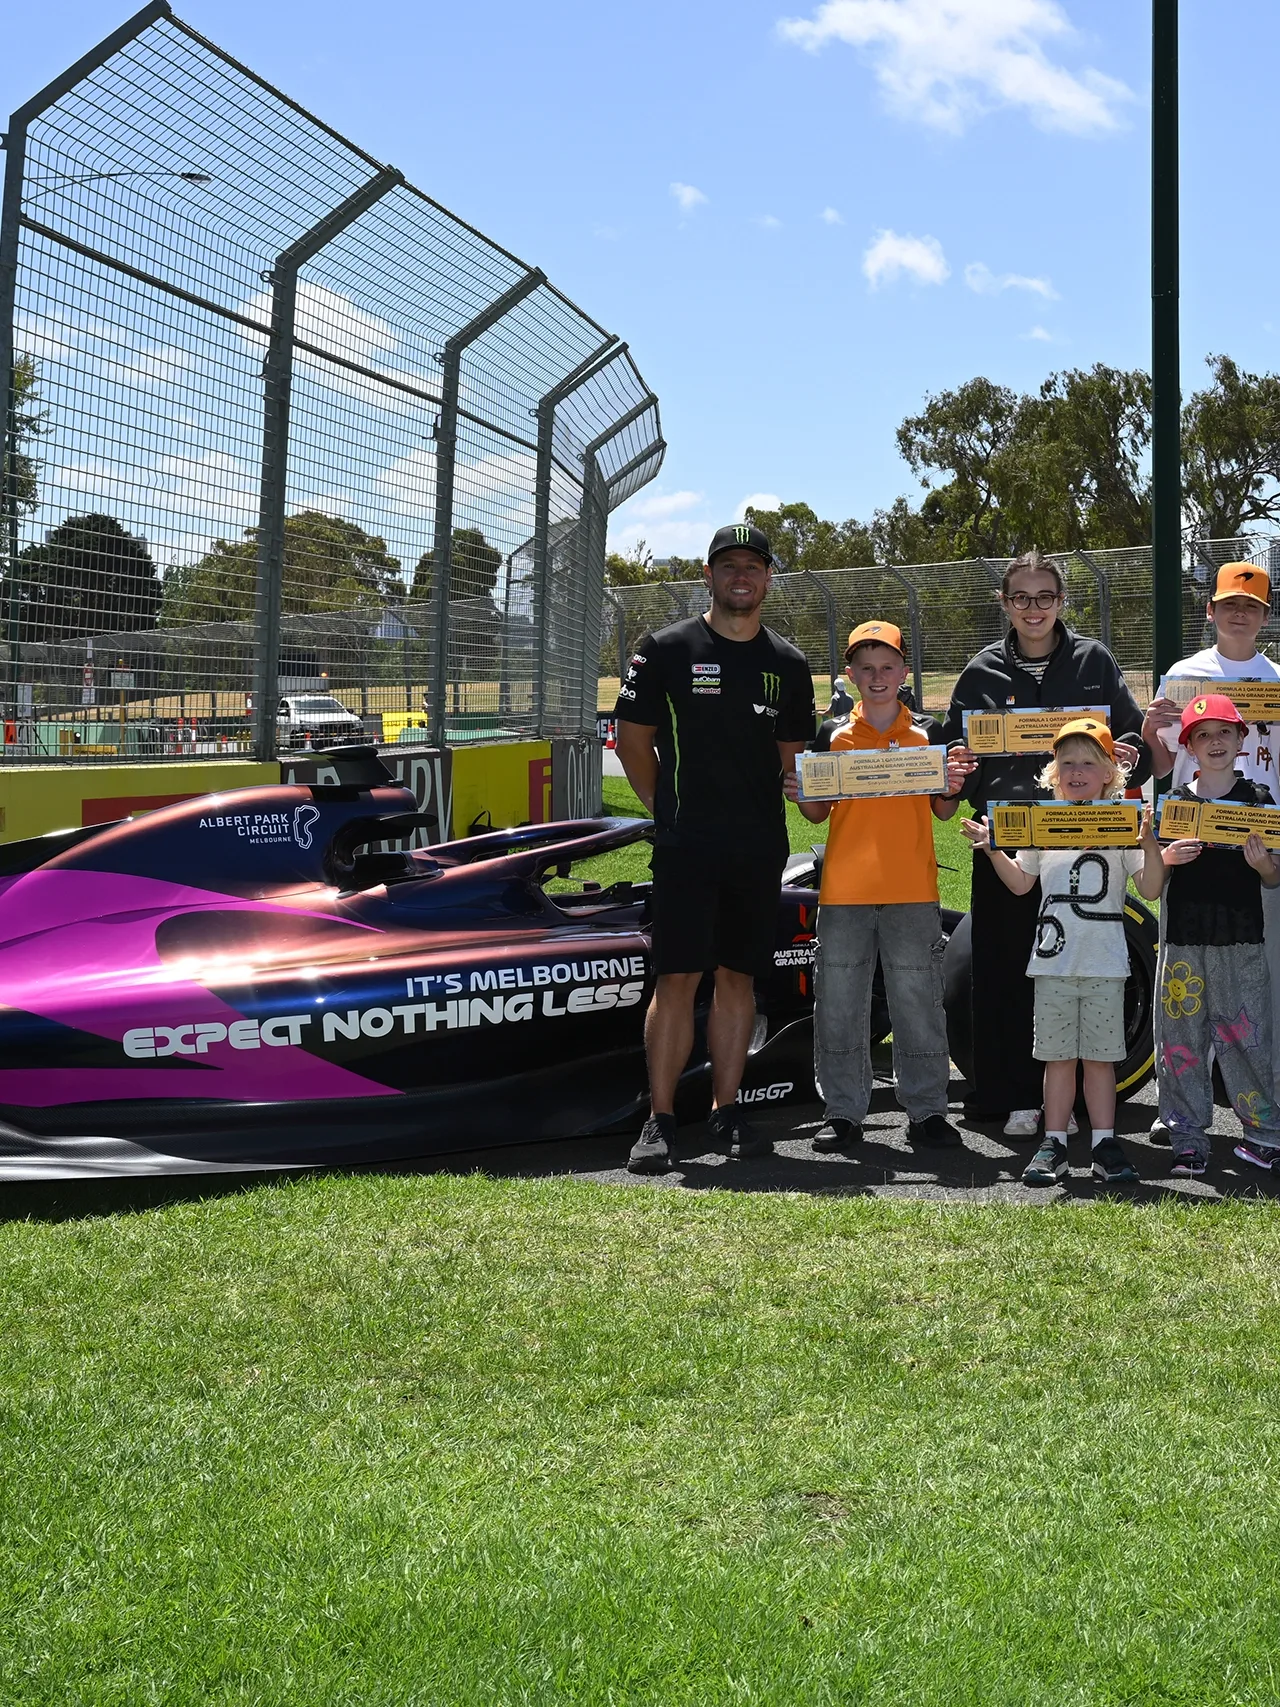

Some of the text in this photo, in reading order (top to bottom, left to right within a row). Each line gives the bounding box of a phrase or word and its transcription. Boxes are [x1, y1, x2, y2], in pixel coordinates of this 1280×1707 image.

[199, 814, 289, 828] ALBERT PARK
[237, 824, 289, 836] CIRCUIT
[773, 949, 815, 958] AUSTRAL
[775, 958, 807, 966] GRAND
[406, 956, 646, 998] IT'S MELBOURNE
[123, 981, 645, 1058] EXPECT NOTHING LESS
